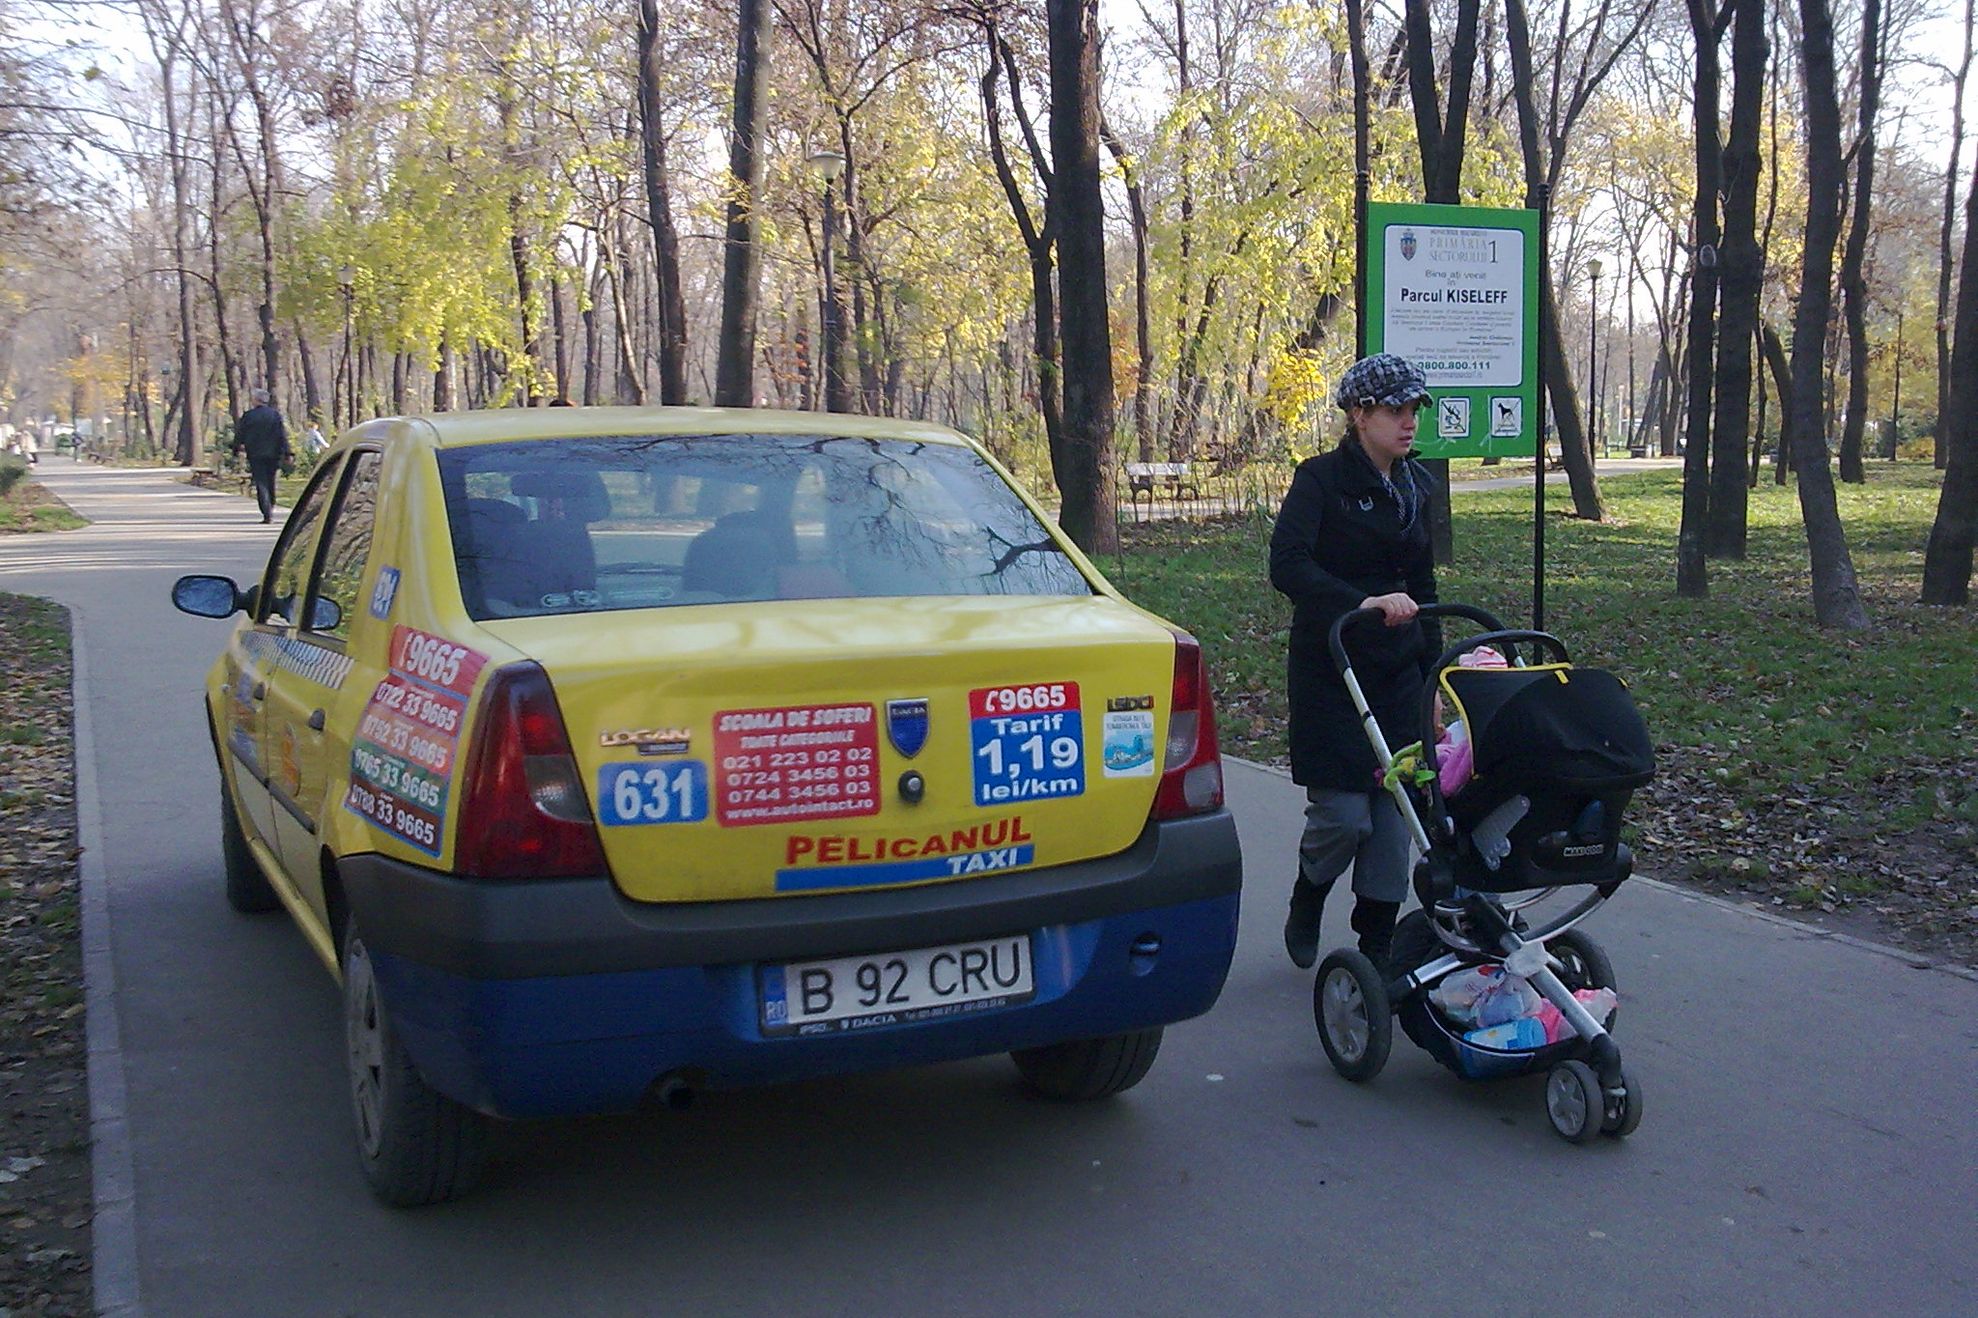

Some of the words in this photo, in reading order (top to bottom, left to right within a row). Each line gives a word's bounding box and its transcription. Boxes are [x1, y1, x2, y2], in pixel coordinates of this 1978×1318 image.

[1488, 240, 1498, 263] 1
[1425, 269, 1447, 279] Bine
[1401, 288, 1442, 302] Parcul
[1447, 289, 1508, 304] KISELEFF
[407, 635, 467, 685] 9665
[999, 685, 1066, 711] 9665
[402, 693, 421, 715] 33
[420, 700, 458, 731] 9665
[786, 710, 809, 727] DE
[991, 713, 1063, 735] Tarif
[391, 728, 408, 751] 33
[408, 736, 448, 768] 9665
[601, 729, 690, 747] LOGAN
[723, 755, 761, 769] 021
[770, 752, 809, 766] 223
[815, 749, 840, 763] 02
[847, 747, 872, 761] 02
[979, 735, 1078, 778] 1,19
[382, 763, 399, 787] 33
[401, 772, 439, 806] 9665
[727, 771, 780, 786] 0724
[788, 766, 838, 782] 3456
[844, 764, 870, 777] 03
[614, 768, 693, 819] 631
[728, 788, 780, 803] 0744
[788, 783, 839, 798] 3456
[846, 781, 870, 794] 03
[983, 778, 1077, 800] lei/km
[377, 799, 393, 824] 33
[396, 809, 434, 844] 9665
[786, 816, 1032, 865] PELICANUL
[947, 848, 1018, 875] TAXI
[766, 1000, 787, 1019] RO
[801, 967, 834, 1015] B
[856, 959, 910, 1006] 92
[929, 942, 1020, 996] CRU
[852, 1014, 897, 1029] DACIA
